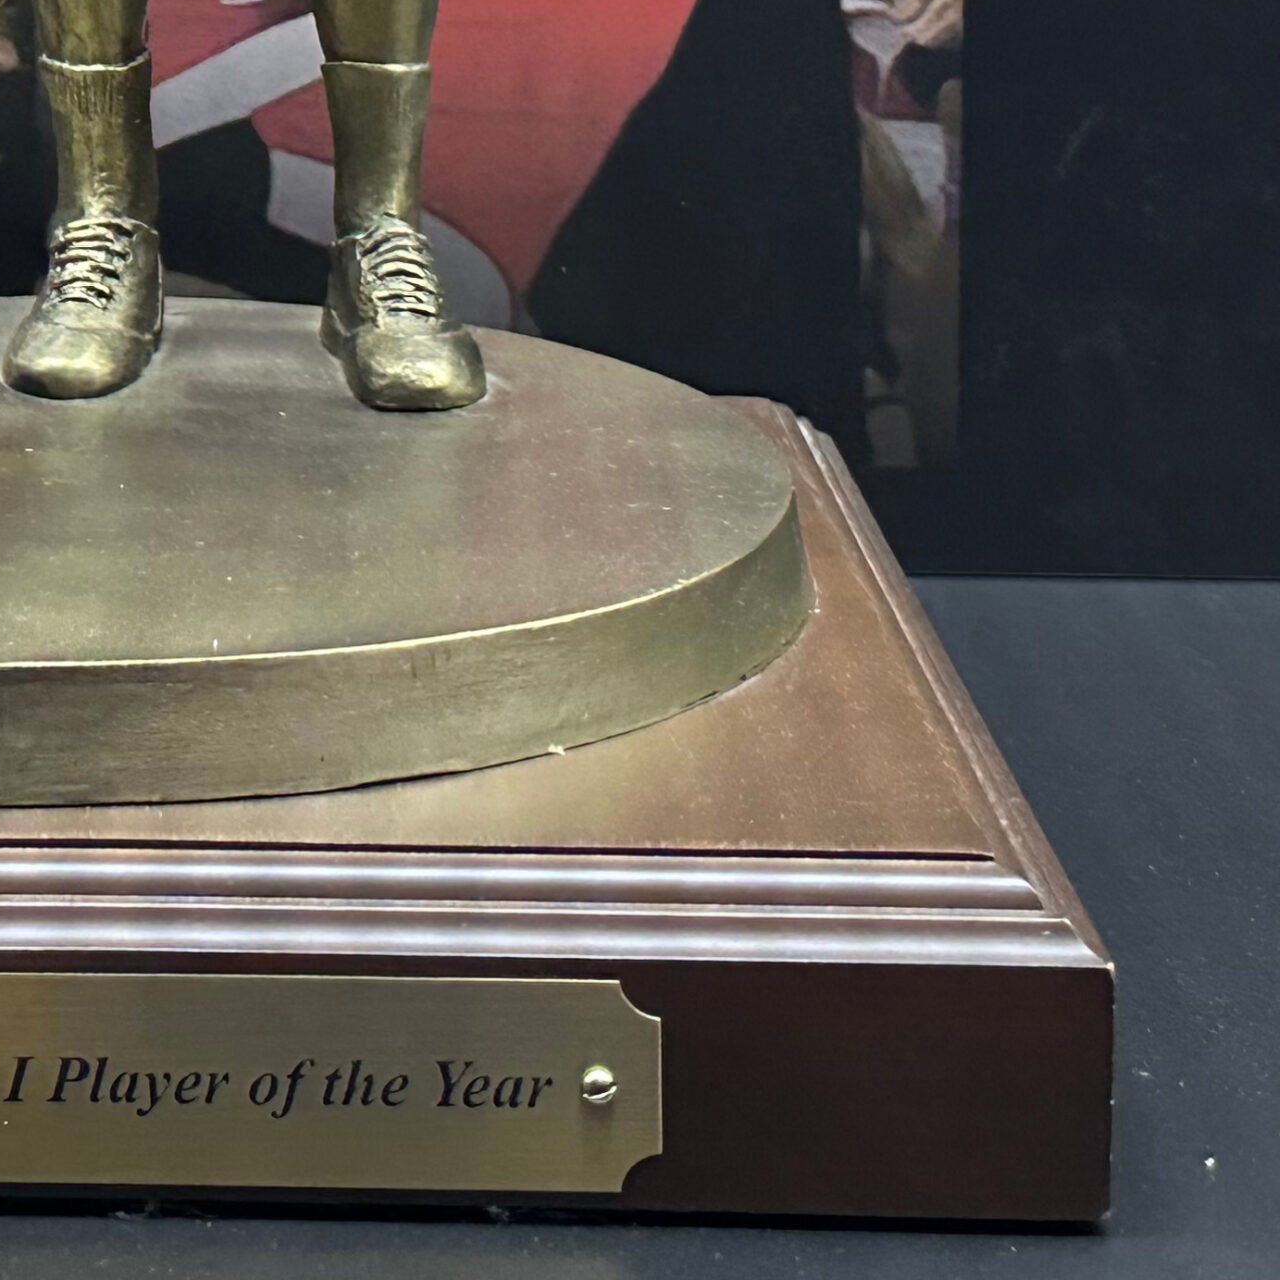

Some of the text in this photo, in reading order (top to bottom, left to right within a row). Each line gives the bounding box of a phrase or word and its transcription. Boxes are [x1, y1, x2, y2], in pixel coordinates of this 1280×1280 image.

[4, 1056, 35, 1102] I
[47, 1056, 230, 1117] Player
[248, 1058, 316, 1119] of
[322, 1059, 410, 1108] the
[435, 1060, 553, 1109] Year
